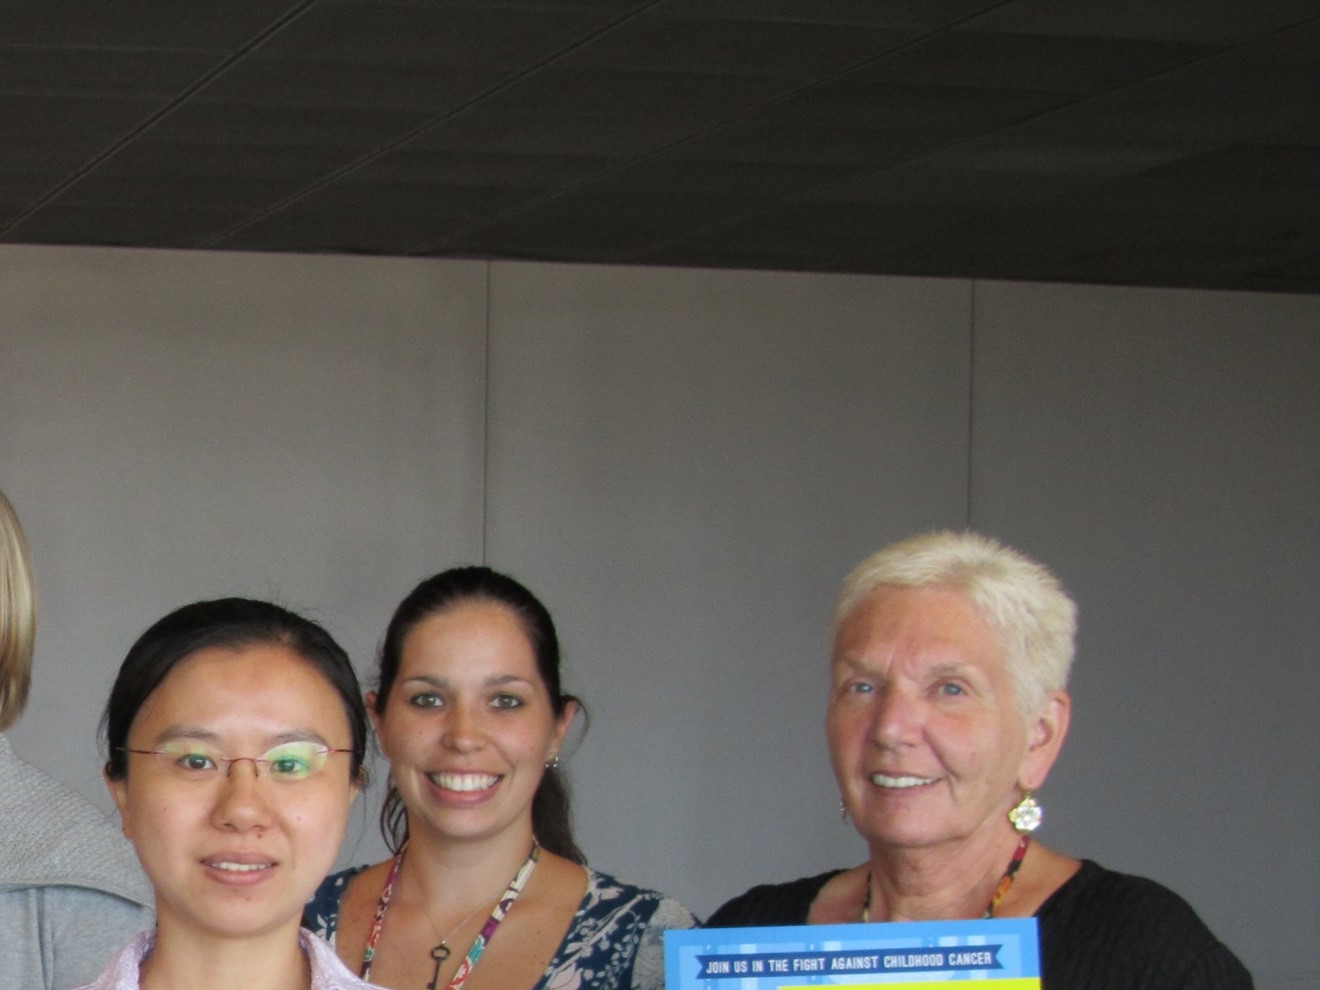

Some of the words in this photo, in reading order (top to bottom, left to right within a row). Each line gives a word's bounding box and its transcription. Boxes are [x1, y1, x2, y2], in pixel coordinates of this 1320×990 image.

[705, 961, 729, 973] JOIN
[733, 960, 747, 972] US
[751, 960, 763, 971] IN
[767, 959, 788, 971] THE
[792, 957, 825, 970] FIGHT
[830, 955, 878, 969] AGAINST
[883, 953, 944, 967] CHILDHOOD
[947, 951, 992, 965] CANCER
